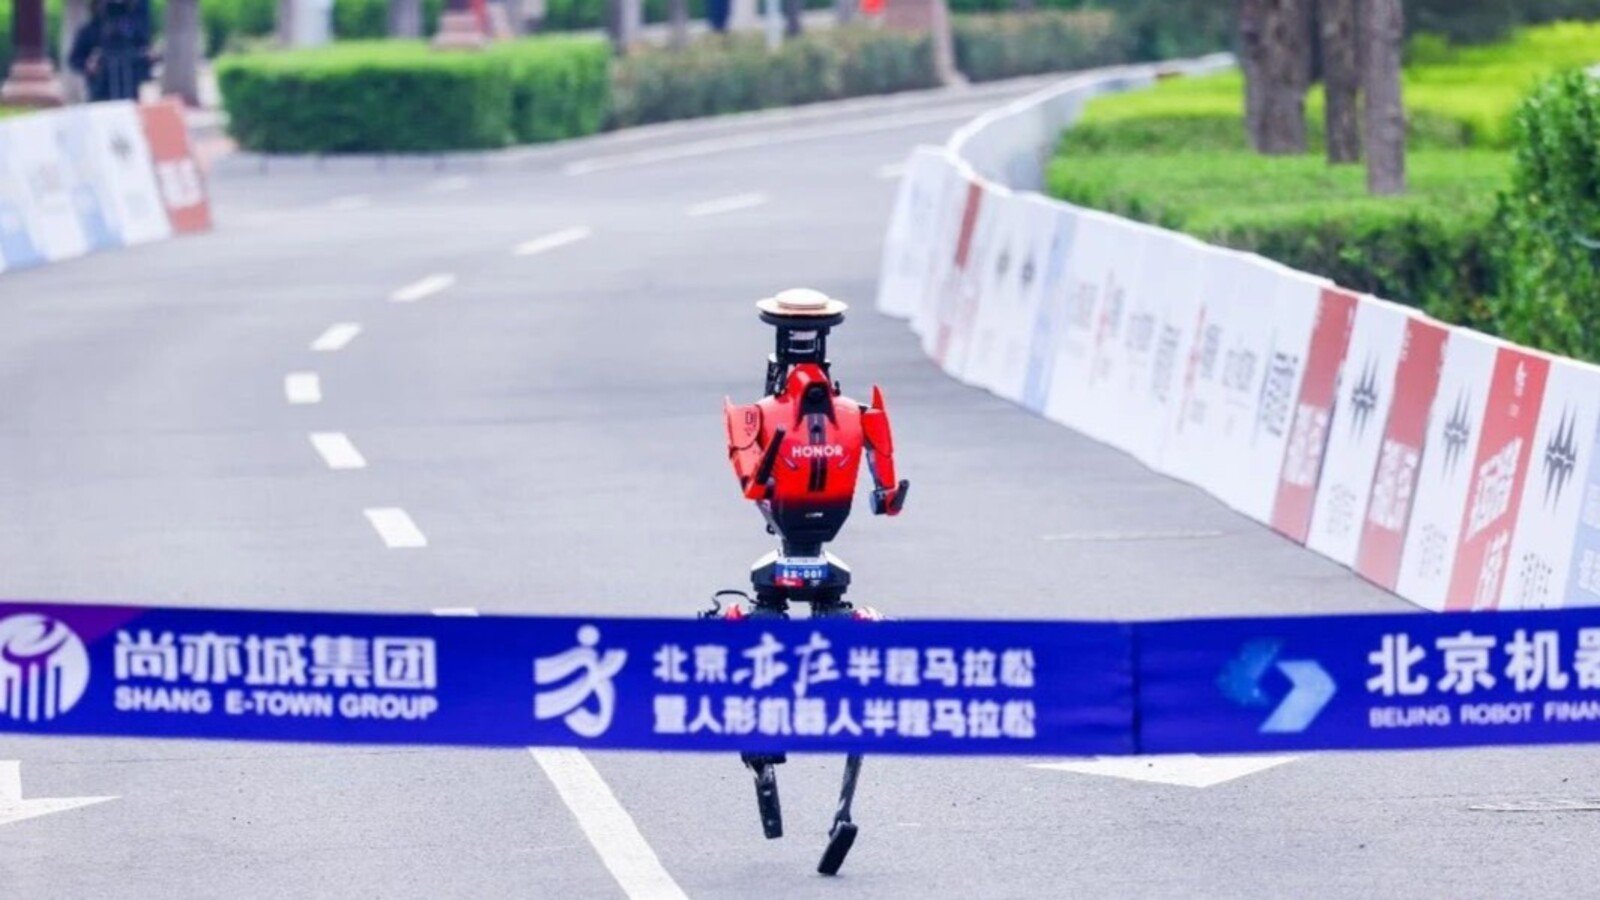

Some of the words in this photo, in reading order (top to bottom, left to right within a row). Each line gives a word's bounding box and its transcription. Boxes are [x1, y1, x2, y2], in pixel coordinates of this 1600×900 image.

[791, 445, 844, 459] HONOR
[114, 630, 437, 689] 尚亦城集团
[115, 685, 212, 713] SHANG
[225, 690, 333, 717] E-TOWN
[339, 693, 438, 720] GROUP
[1369, 705, 1451, 728] BEIJING
[1460, 702, 1532, 724] ROBOT
